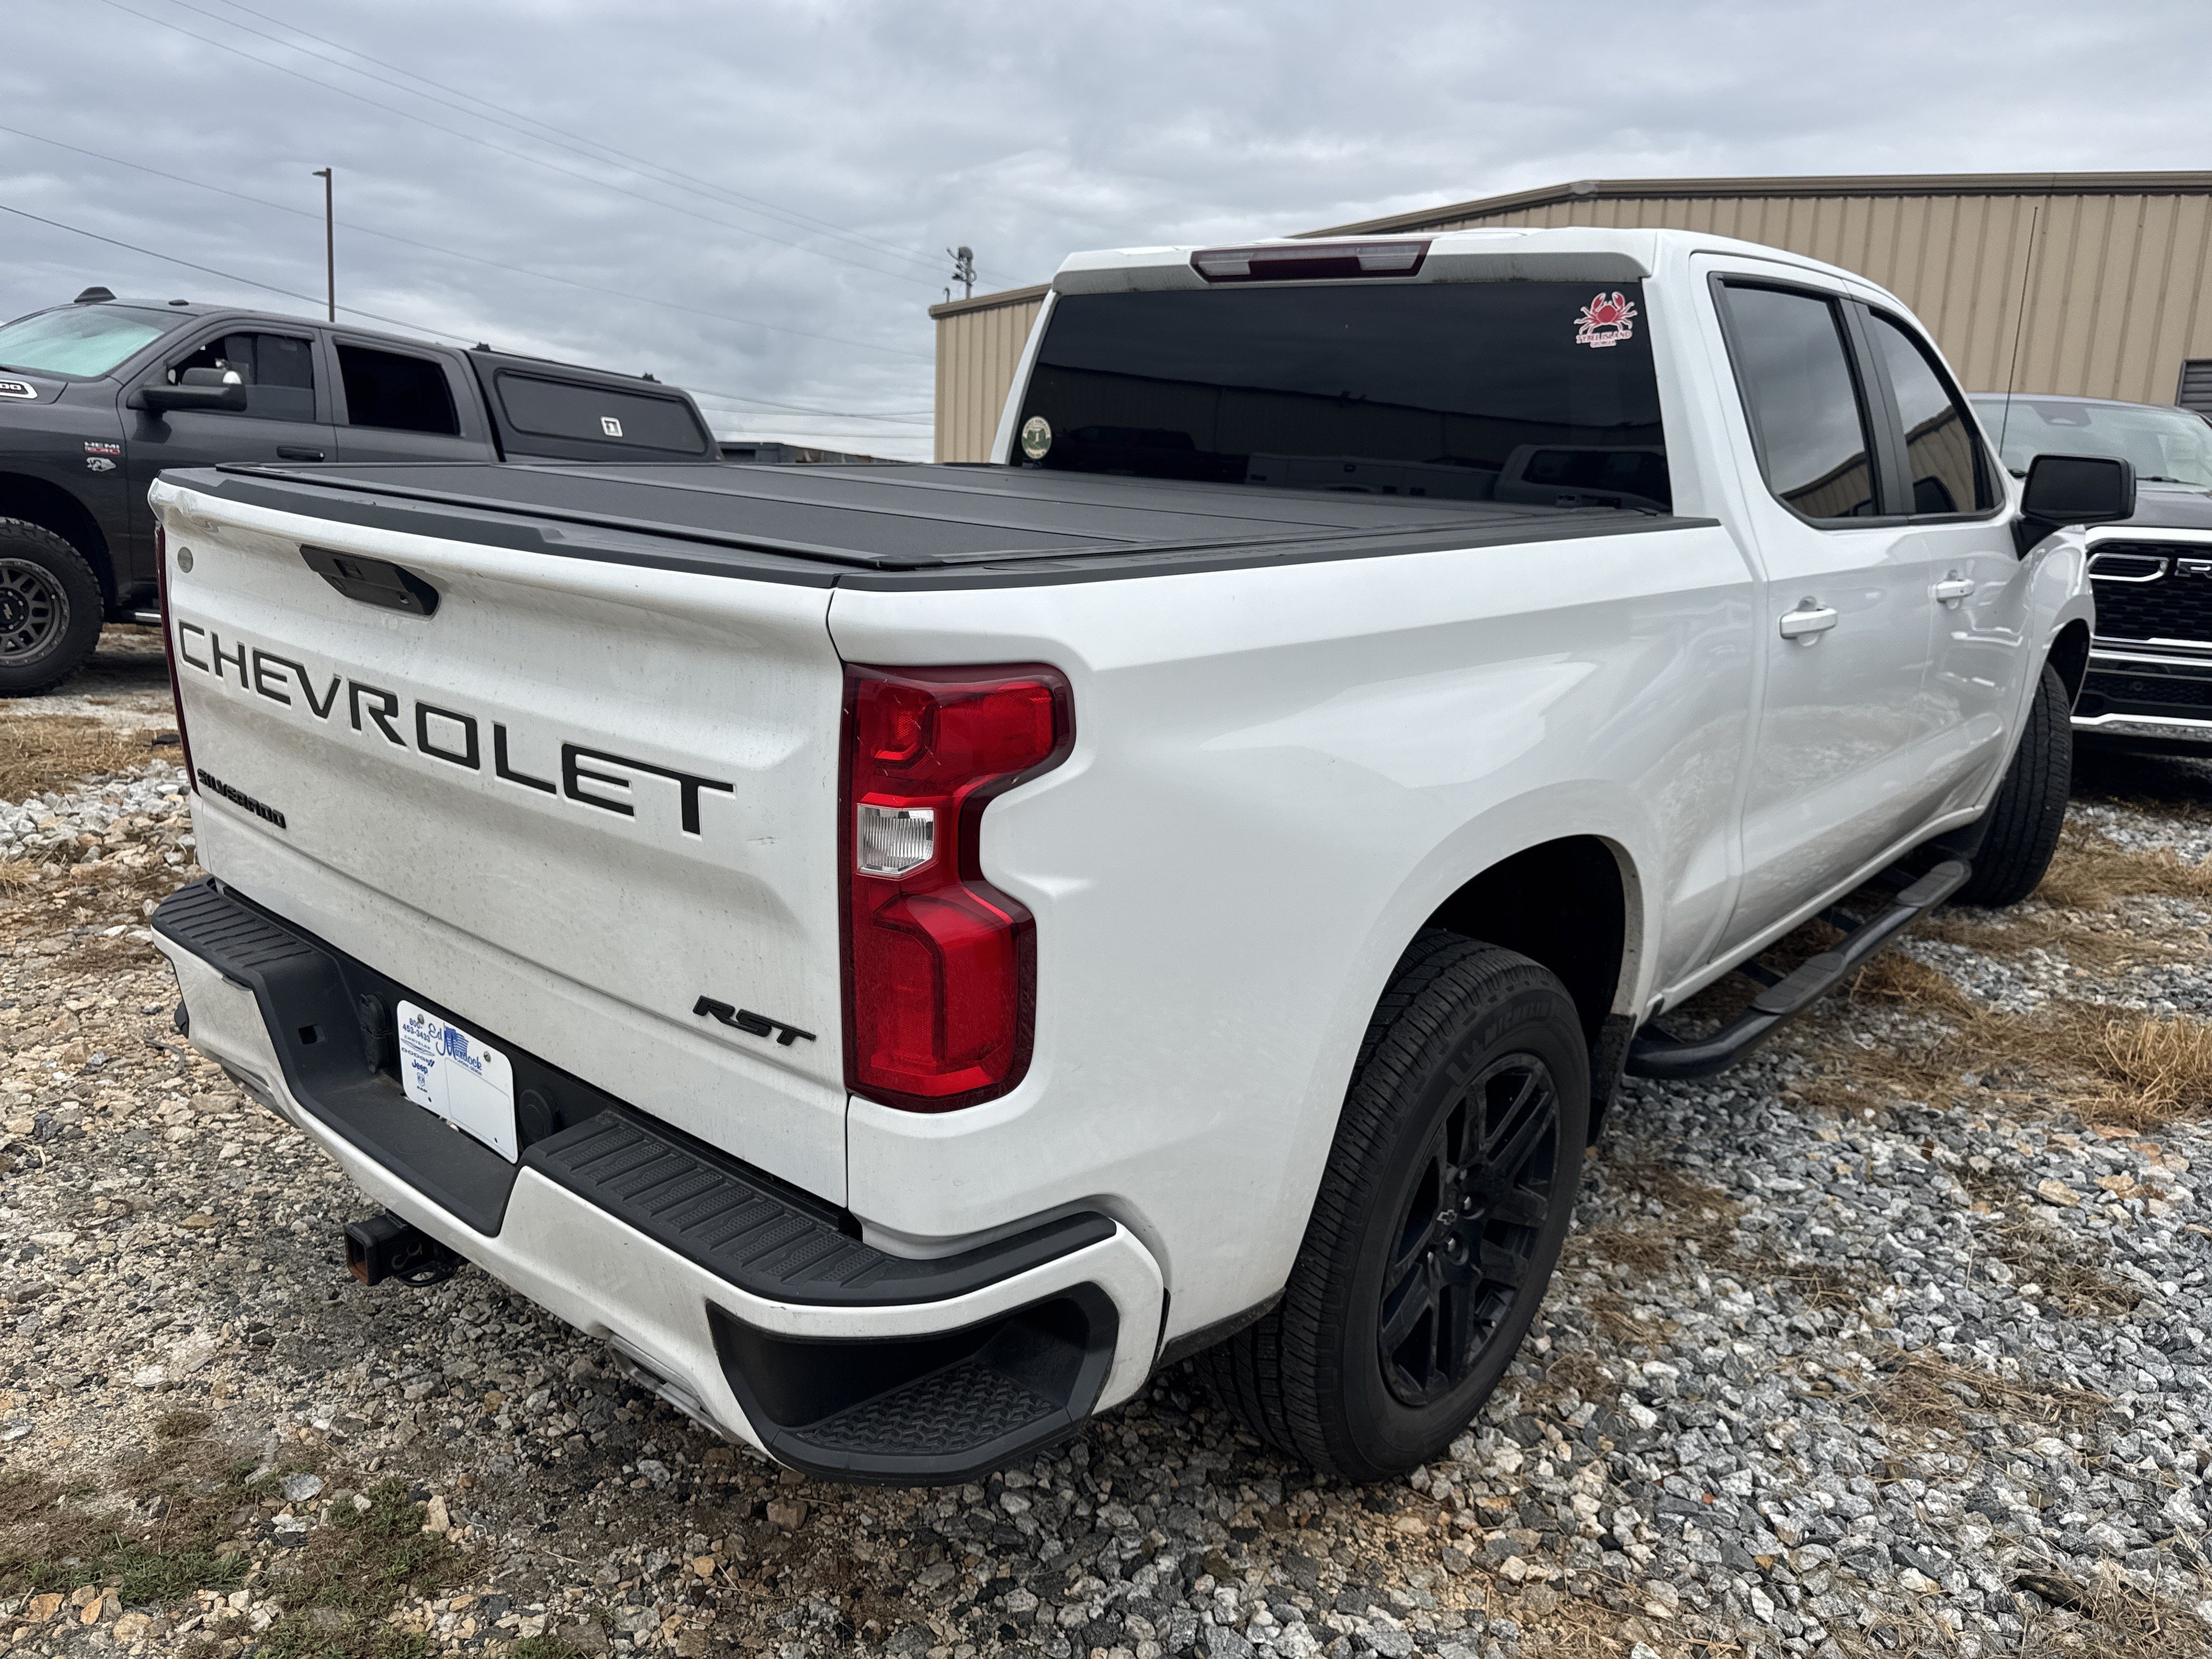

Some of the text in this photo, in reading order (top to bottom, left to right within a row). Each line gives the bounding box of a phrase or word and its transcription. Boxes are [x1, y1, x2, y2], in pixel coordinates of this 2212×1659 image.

[179, 620, 735, 835] CHEVROLET
[197, 768, 286, 829] SILVERADO
[428, 1023, 443, 1041] Ed
[692, 995, 817, 1046] RST
[411, 1059, 428, 1075] Jeep
